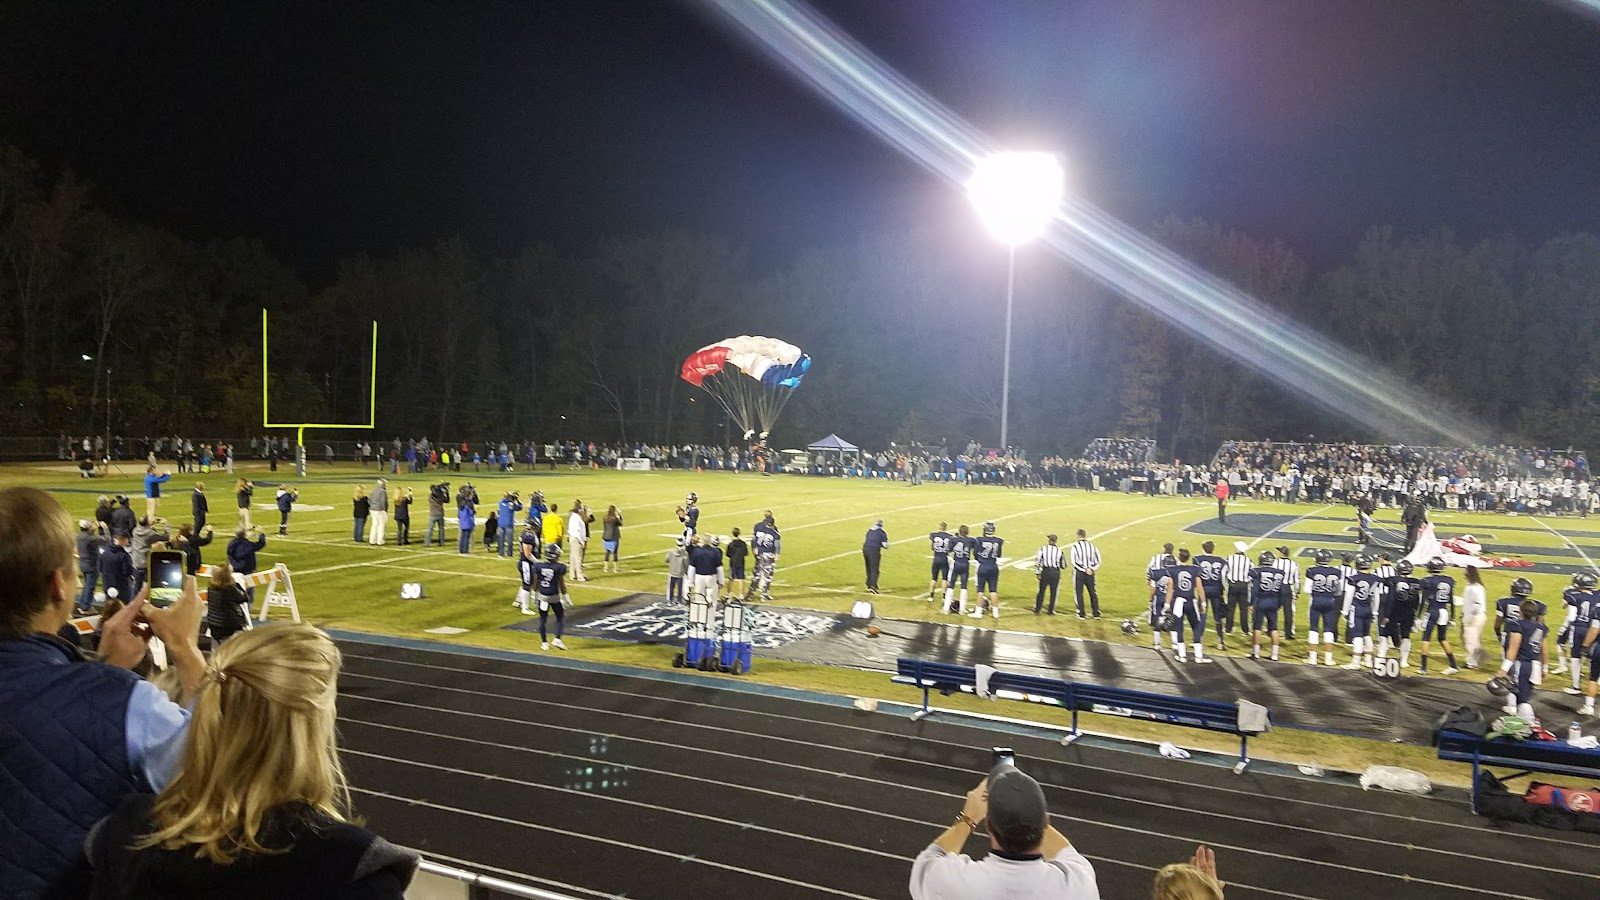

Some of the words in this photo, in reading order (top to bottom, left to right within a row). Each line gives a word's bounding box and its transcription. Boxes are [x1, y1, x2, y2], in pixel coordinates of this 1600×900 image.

[1178, 571, 1192, 591] 6
[1436, 582, 1450, 602] 2
[1373, 658, 1399, 677] 50
